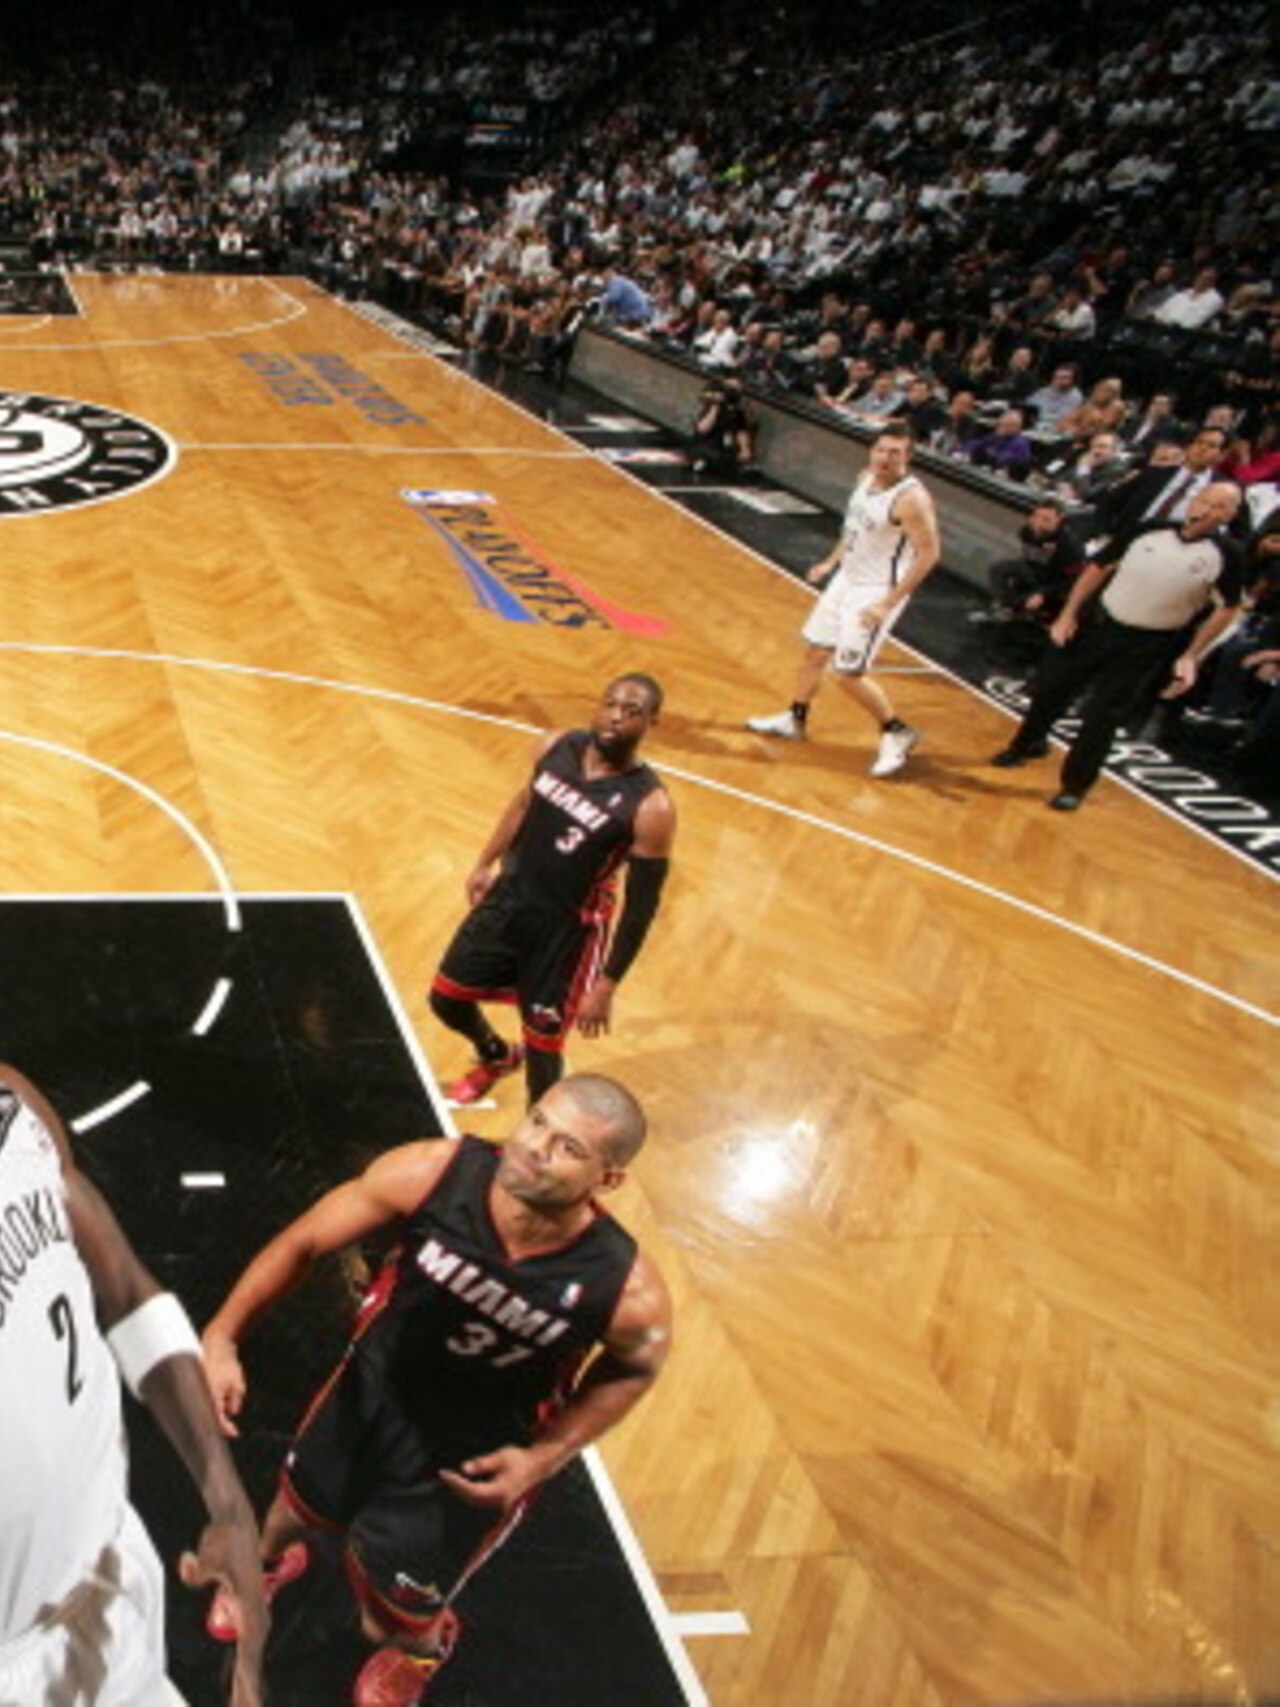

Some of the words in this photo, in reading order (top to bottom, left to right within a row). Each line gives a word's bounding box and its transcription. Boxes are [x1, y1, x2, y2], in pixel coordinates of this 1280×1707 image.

[533, 771, 609, 833] MIAMI
[555, 825, 587, 854] 3
[416, 1239, 571, 1346] MIAMI
[47, 1292, 84, 1407] 2
